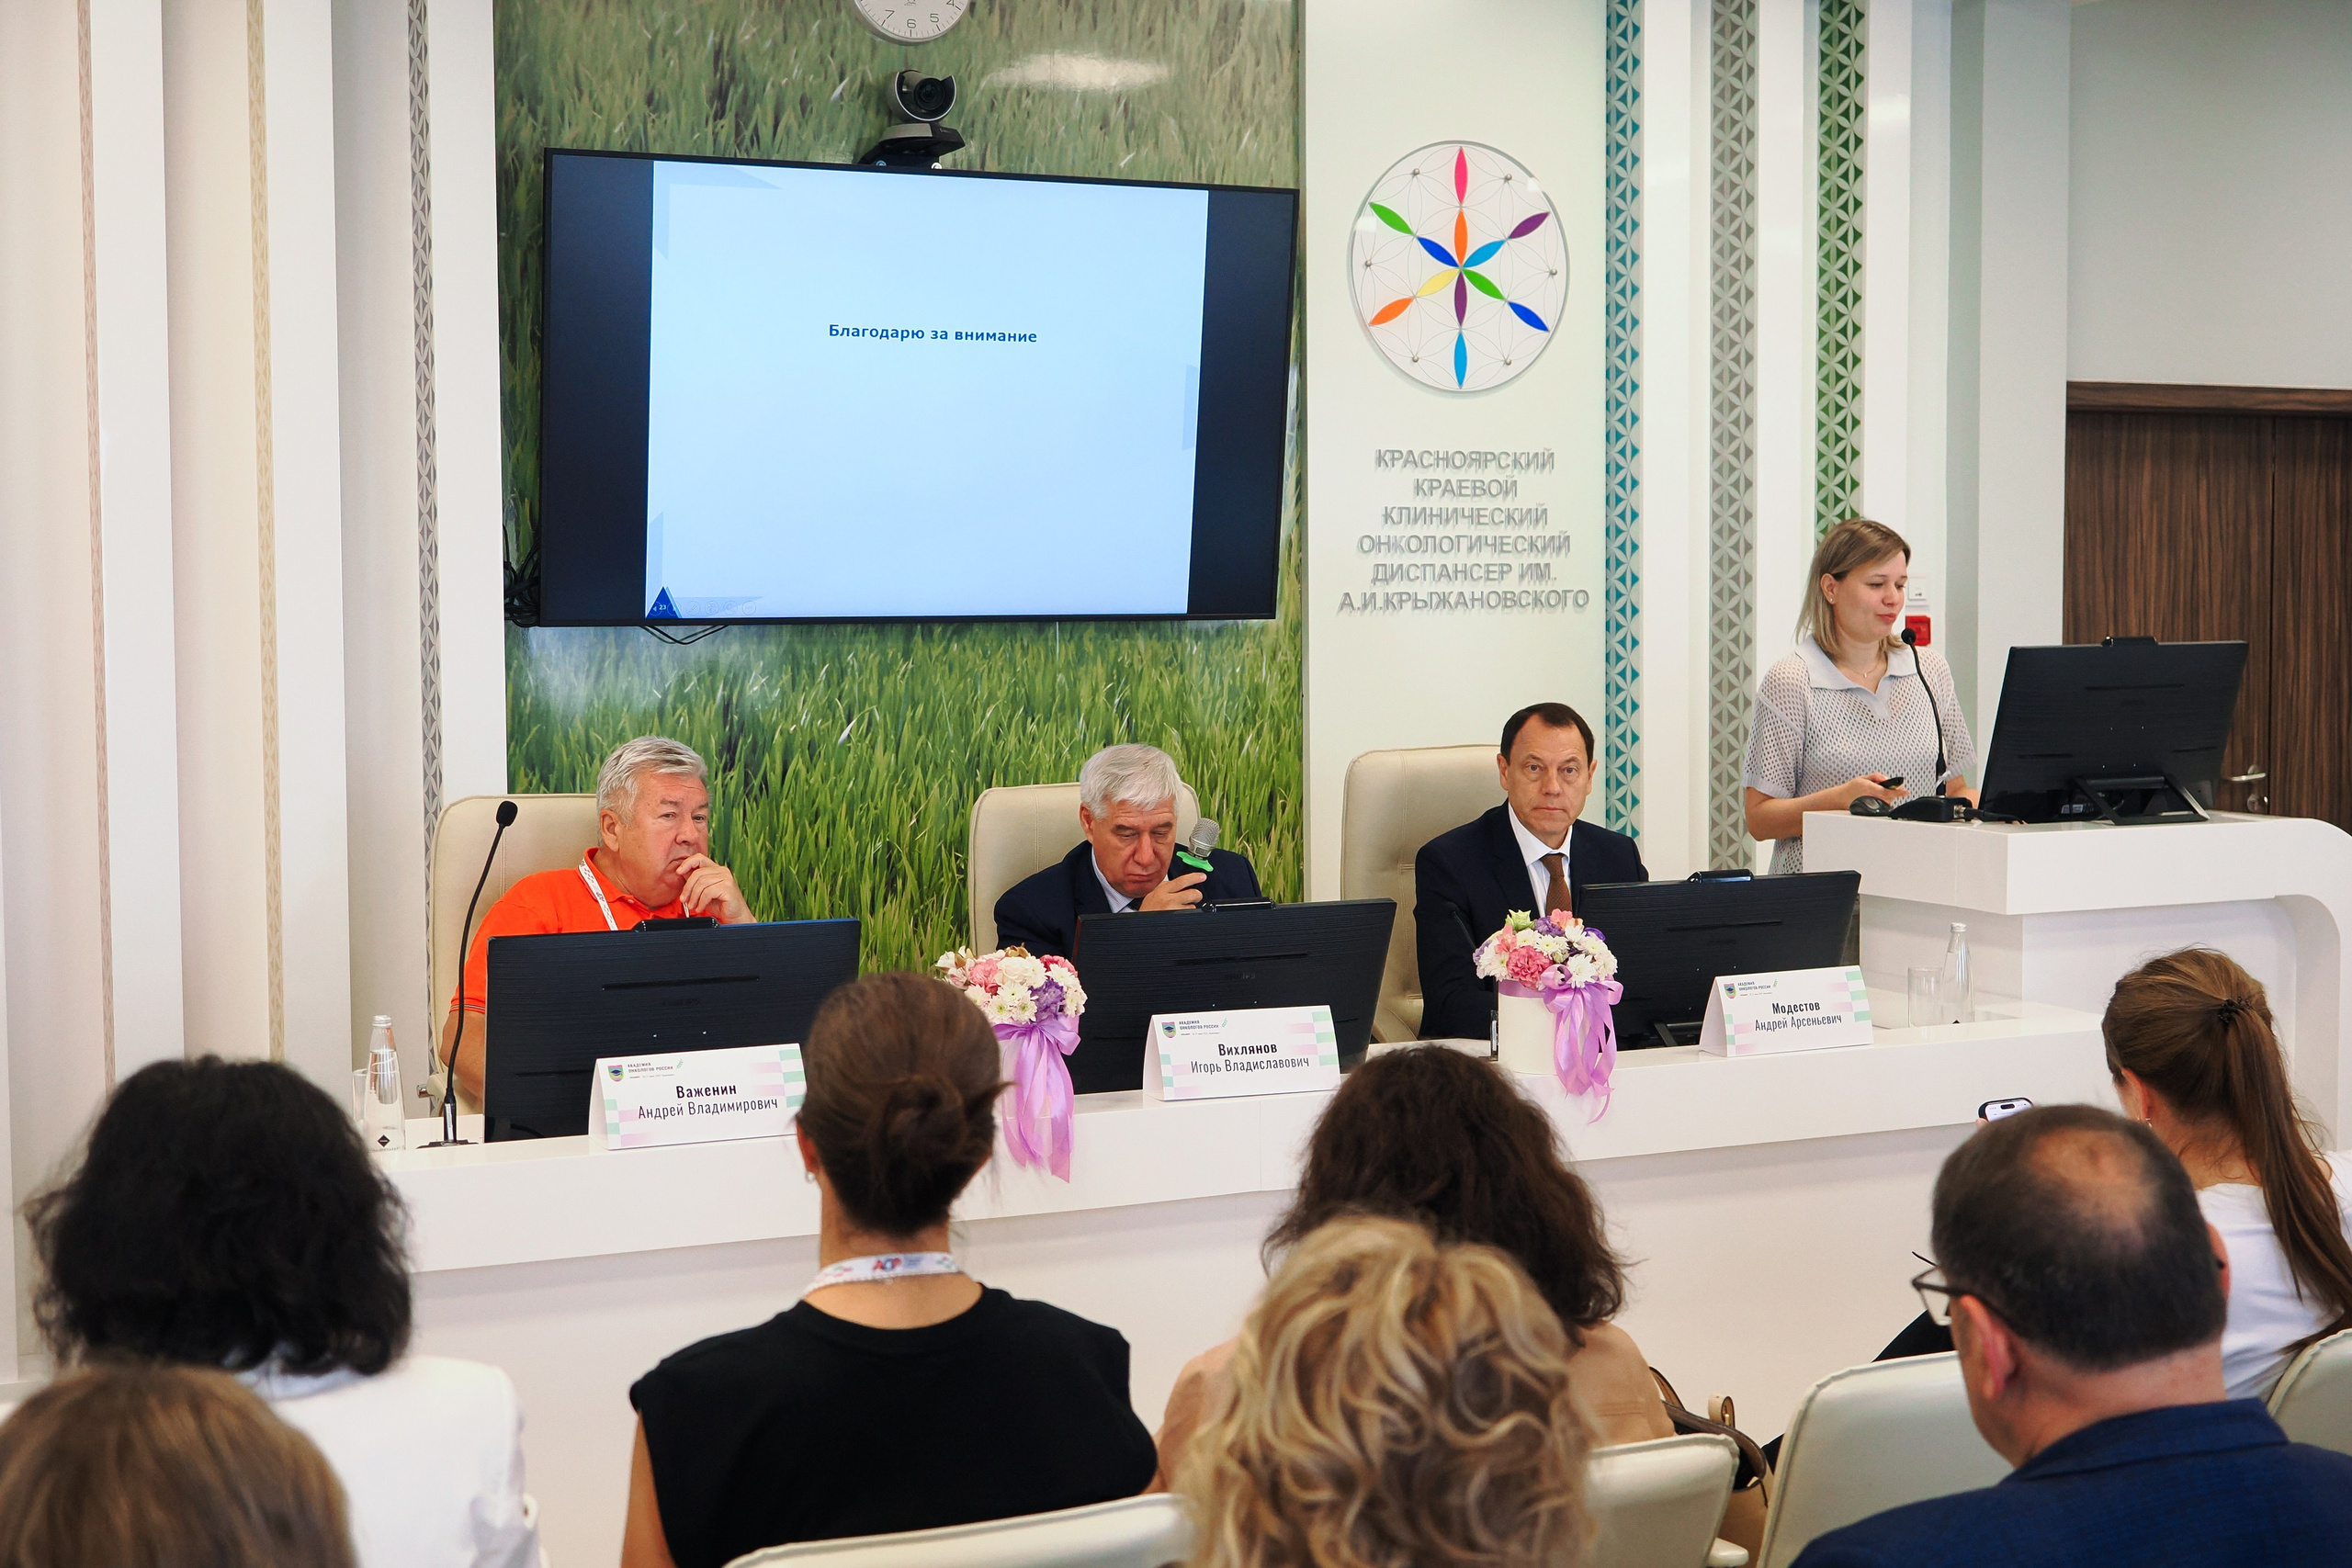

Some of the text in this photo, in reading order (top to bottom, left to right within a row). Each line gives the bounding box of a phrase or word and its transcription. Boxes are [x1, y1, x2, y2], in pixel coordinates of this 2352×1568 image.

[885, 9, 895, 19] 7
[906, 18, 917, 28] 6
[930, 13, 939, 23] 5
[829, 324, 1037, 343] Благодарю за внимание
[1375, 447, 1555, 470] КРАСНОЯРСКИЙ
[1414, 475, 1518, 497] КРАЕВОЙ
[1383, 502, 1548, 525] КЛИНИЧЕСКИЙ
[1358, 531, 1571, 554] ОНКОЛОГИЧЕСКИЙ
[1371, 562, 1557, 584] ДИСПАНСЕР ИМ.
[1338, 589, 1590, 612] А.И.КРЫЖАНОВСКОГО
[1771, 1001, 1821, 1015] Модестов
[1755, 1014, 1842, 1032] Андрей Арсеньевич
[1218, 1043, 1278, 1056] Вихлянов
[1191, 1056, 1310, 1076] Игорь Владиславович
[675, 1084, 738, 1100] Важенин
[638, 1099, 779, 1121] Андрей Владимирович
